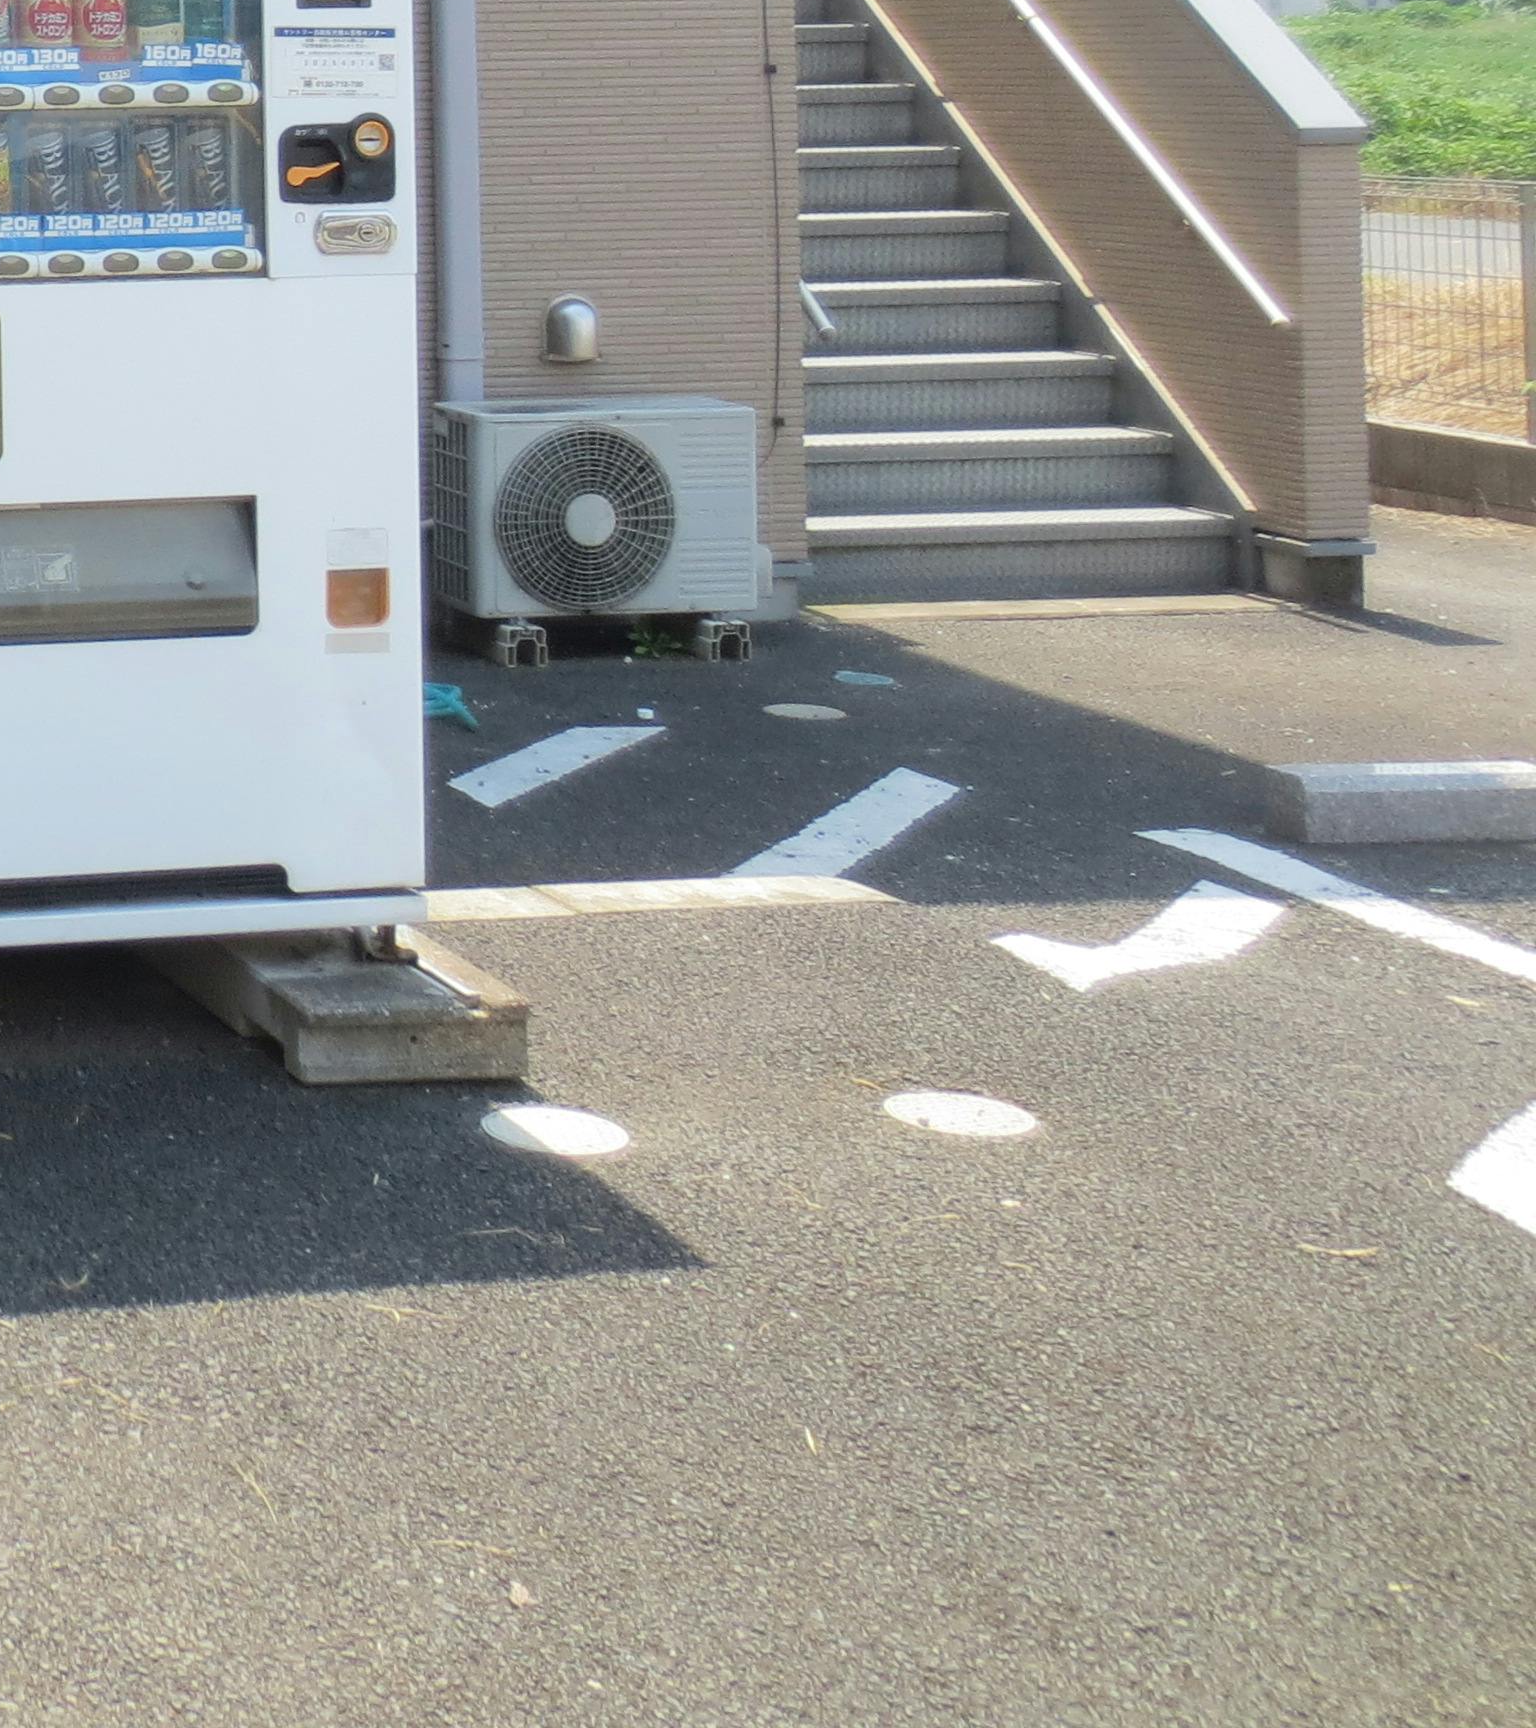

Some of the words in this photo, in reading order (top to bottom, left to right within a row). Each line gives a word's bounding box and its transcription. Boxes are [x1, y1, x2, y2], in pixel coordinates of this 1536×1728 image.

[31, 48, 79, 63] 130円
[144, 45, 192, 60] 160円
[195, 43, 242, 59] 160円
[46, 215, 92, 230] 120円
[97, 214, 144, 229] 120円
[149, 212, 194, 227] 120円
[196, 211, 242, 226] 120円
